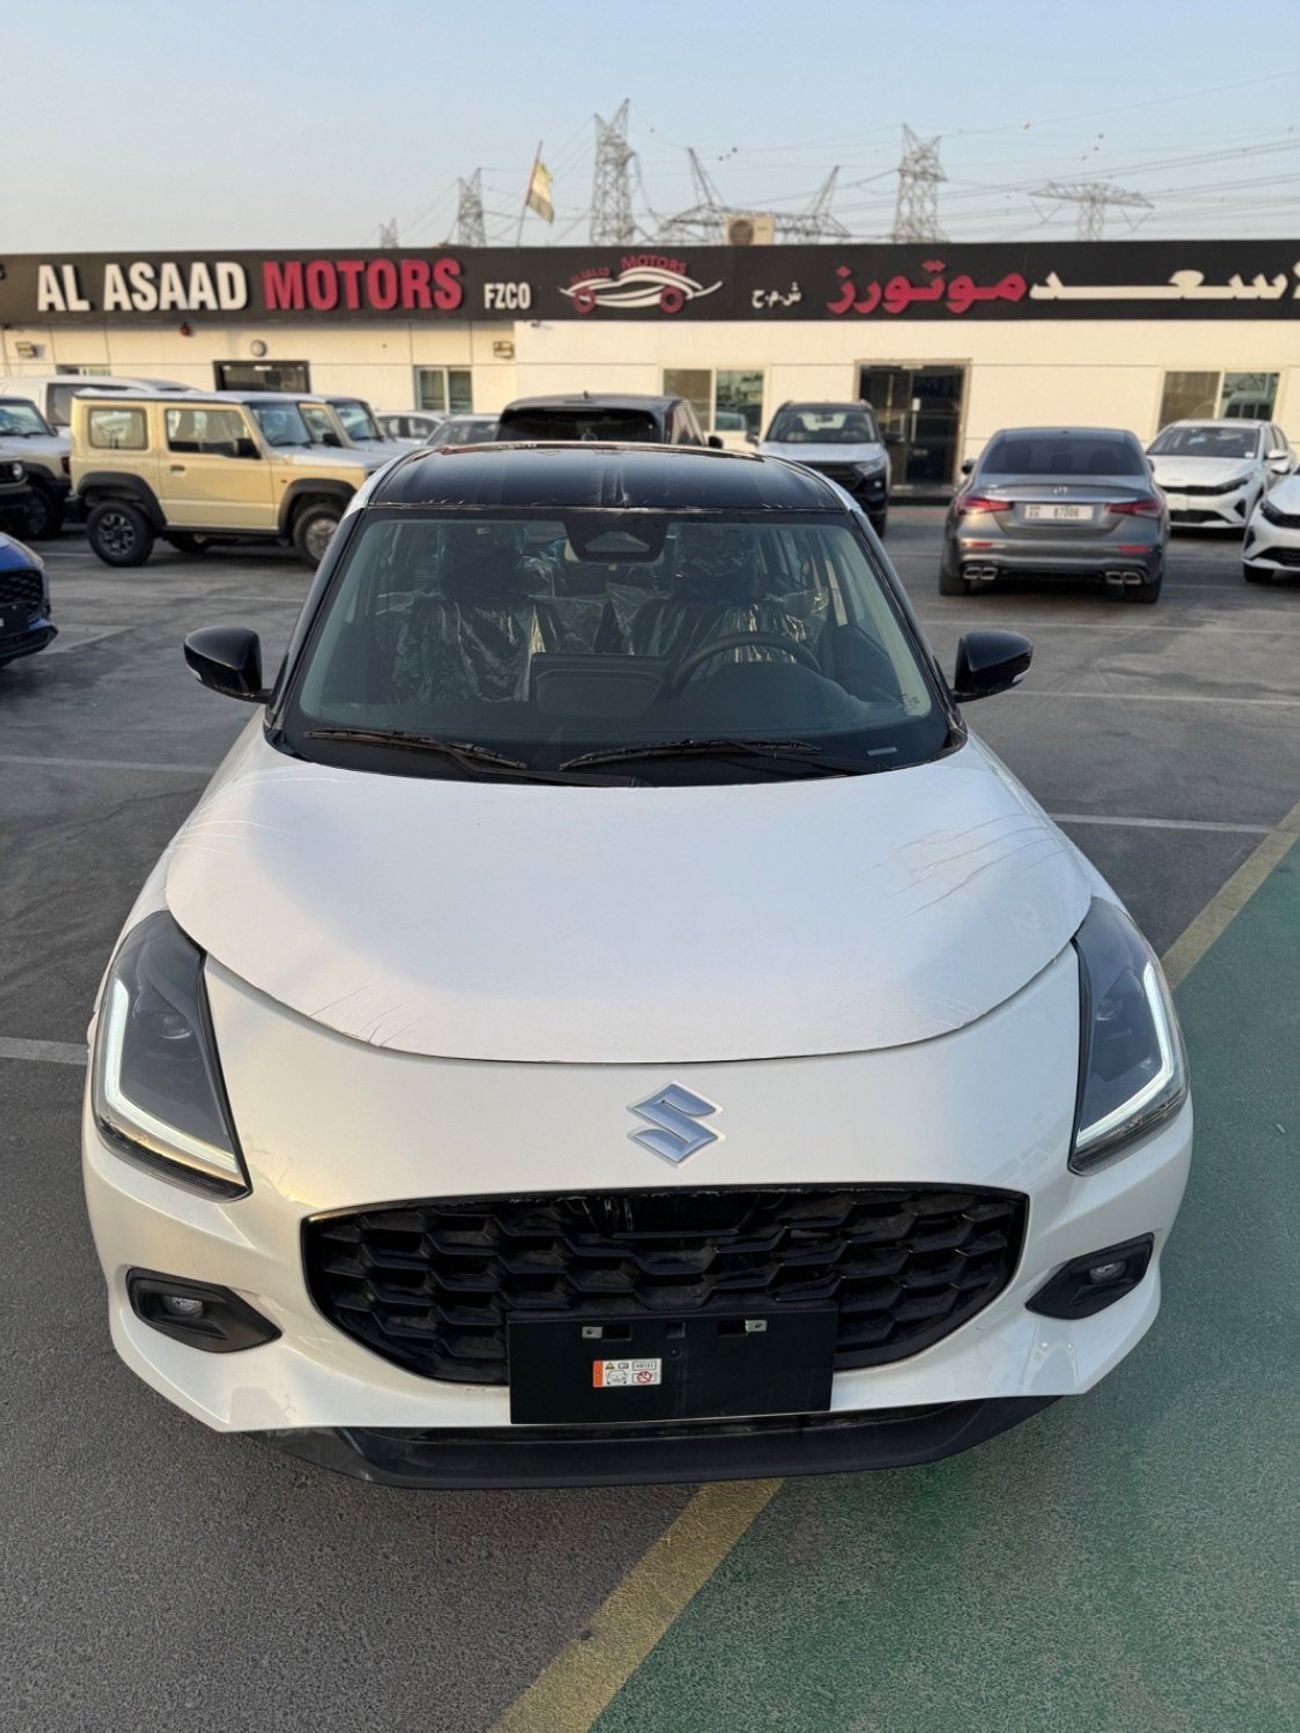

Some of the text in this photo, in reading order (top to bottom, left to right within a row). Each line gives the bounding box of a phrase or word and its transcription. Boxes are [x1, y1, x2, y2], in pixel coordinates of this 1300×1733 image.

[37, 257, 532, 312] AL ASAAD MOTORS FZCO
[620, 254, 687, 275] MOTORS
[827, 259, 1027, 314] موتورز
